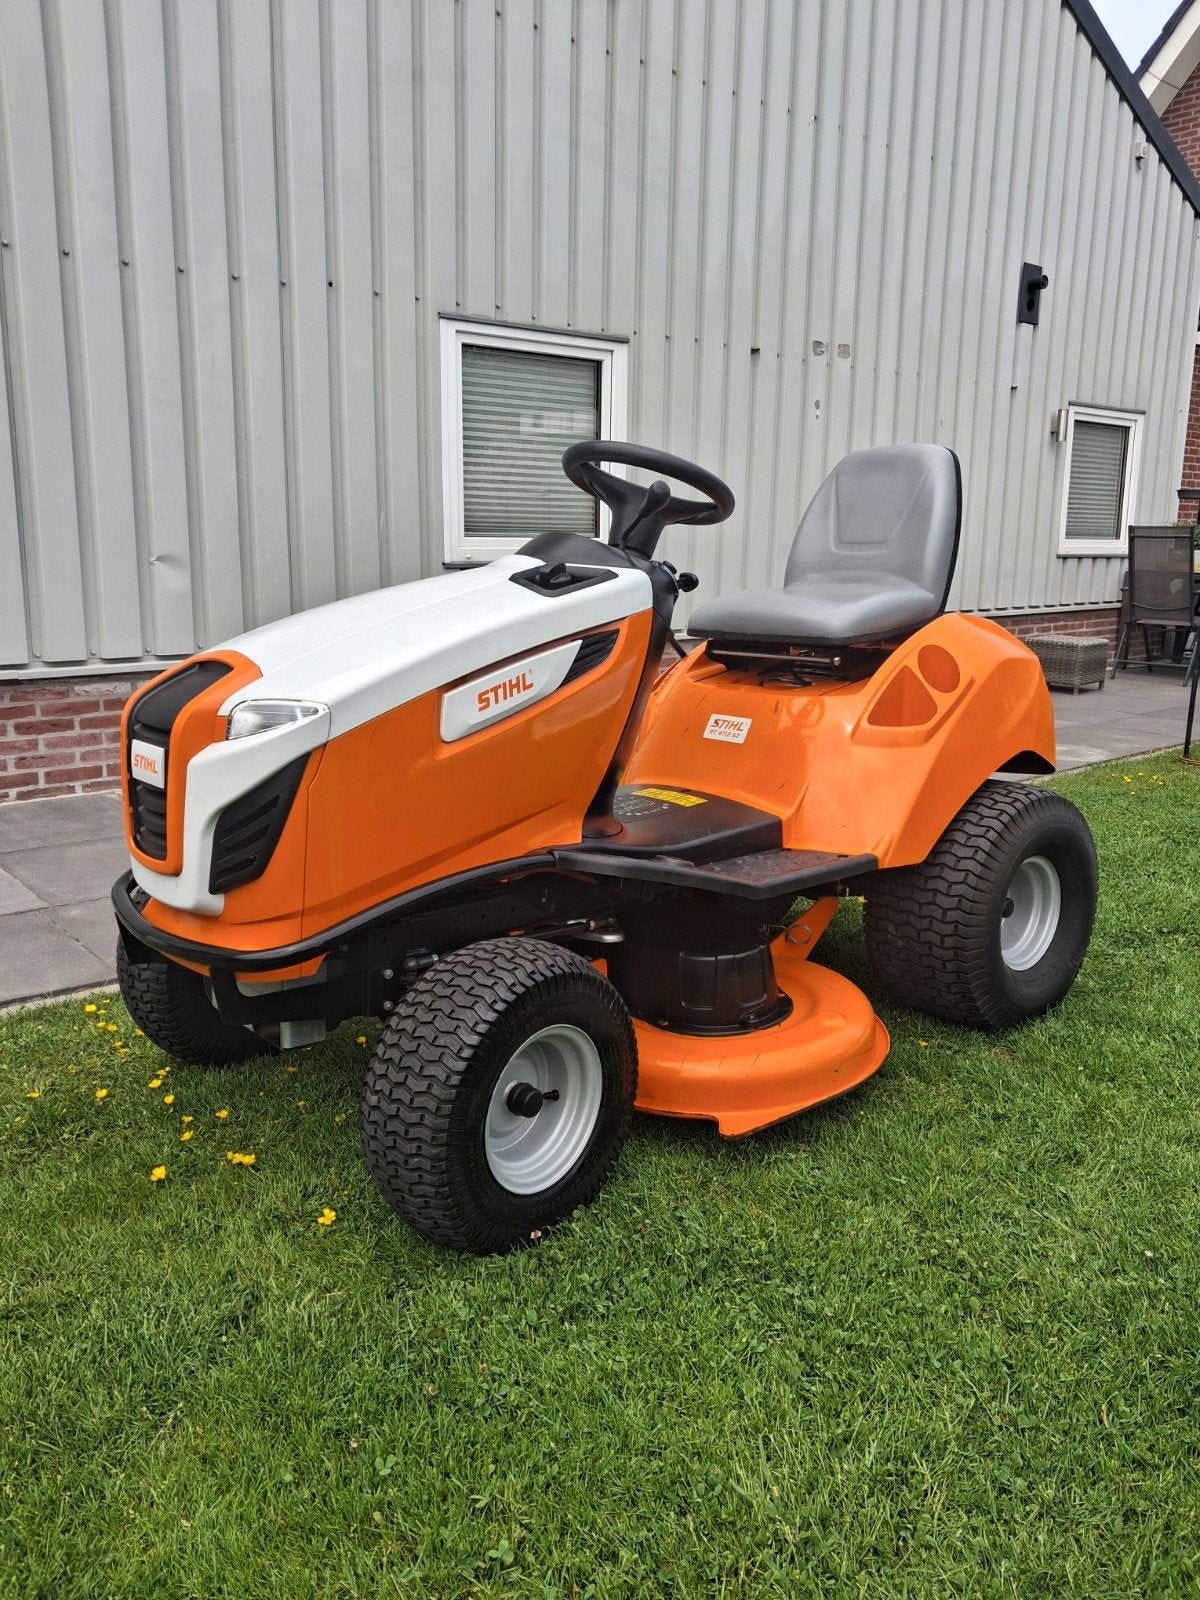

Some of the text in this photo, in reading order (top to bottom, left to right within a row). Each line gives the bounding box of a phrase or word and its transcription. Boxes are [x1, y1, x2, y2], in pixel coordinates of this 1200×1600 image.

[477, 672, 534, 712] STIHL
[711, 718, 744, 731] STIHL
[133, 753, 159, 775] STIHL
